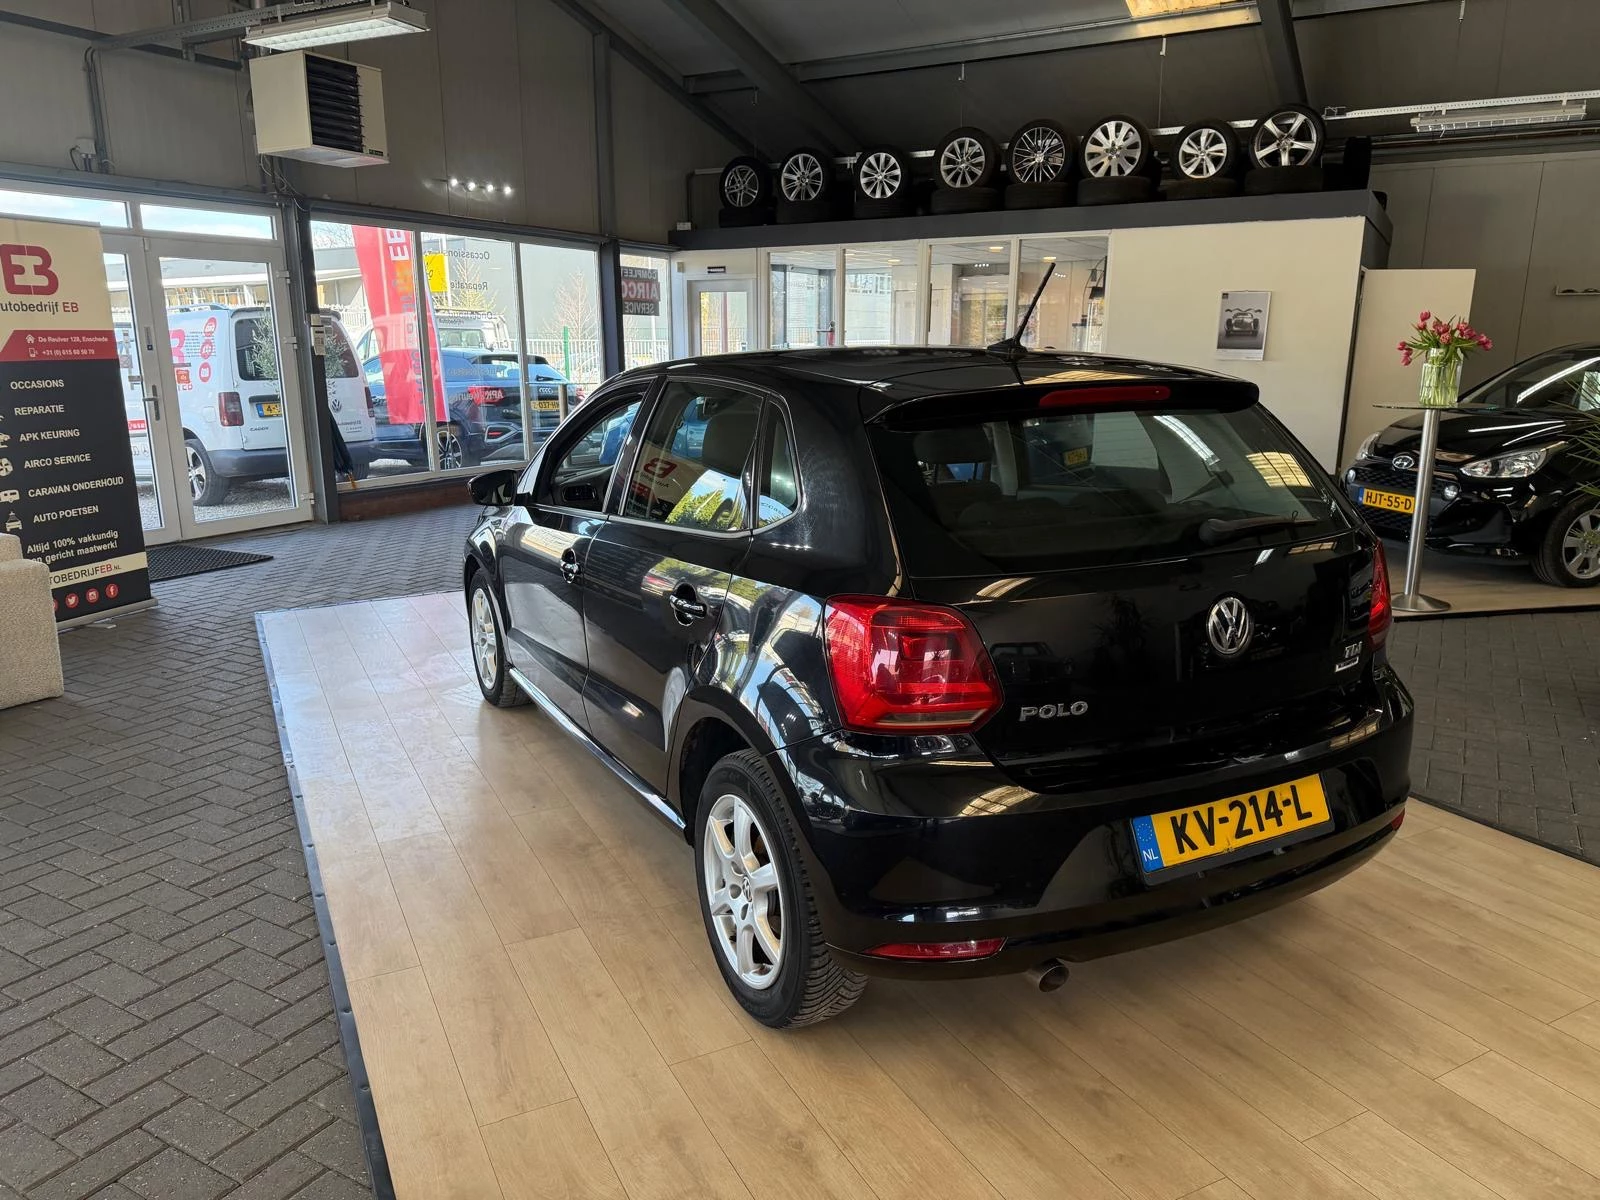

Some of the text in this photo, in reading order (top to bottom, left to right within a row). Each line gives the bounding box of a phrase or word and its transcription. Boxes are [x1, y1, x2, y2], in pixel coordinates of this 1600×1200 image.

[0, 301, 79, 315] utobedrijf EB
[10, 379, 65, 390] OCCASIONS
[14, 404, 65, 416] REPARATIE
[19, 428, 80, 442] APK KEURING
[24, 453, 92, 469] AIRCO SERVICE
[28, 476, 124, 498] CARAVAN ONDERHOUD
[1365, 490, 1412, 511] HJT-55-D
[33, 505, 99, 524] AUTO POETSEN
[27, 529, 119, 554] Altijd 100% vakkundig
[45, 550, 75, 565] gericht
[76, 540, 118, 556] maatwerk!
[1019, 700, 1089, 722] POLO
[1169, 784, 1313, 855] KV-214-L
[1142, 847, 1159, 862] NL
